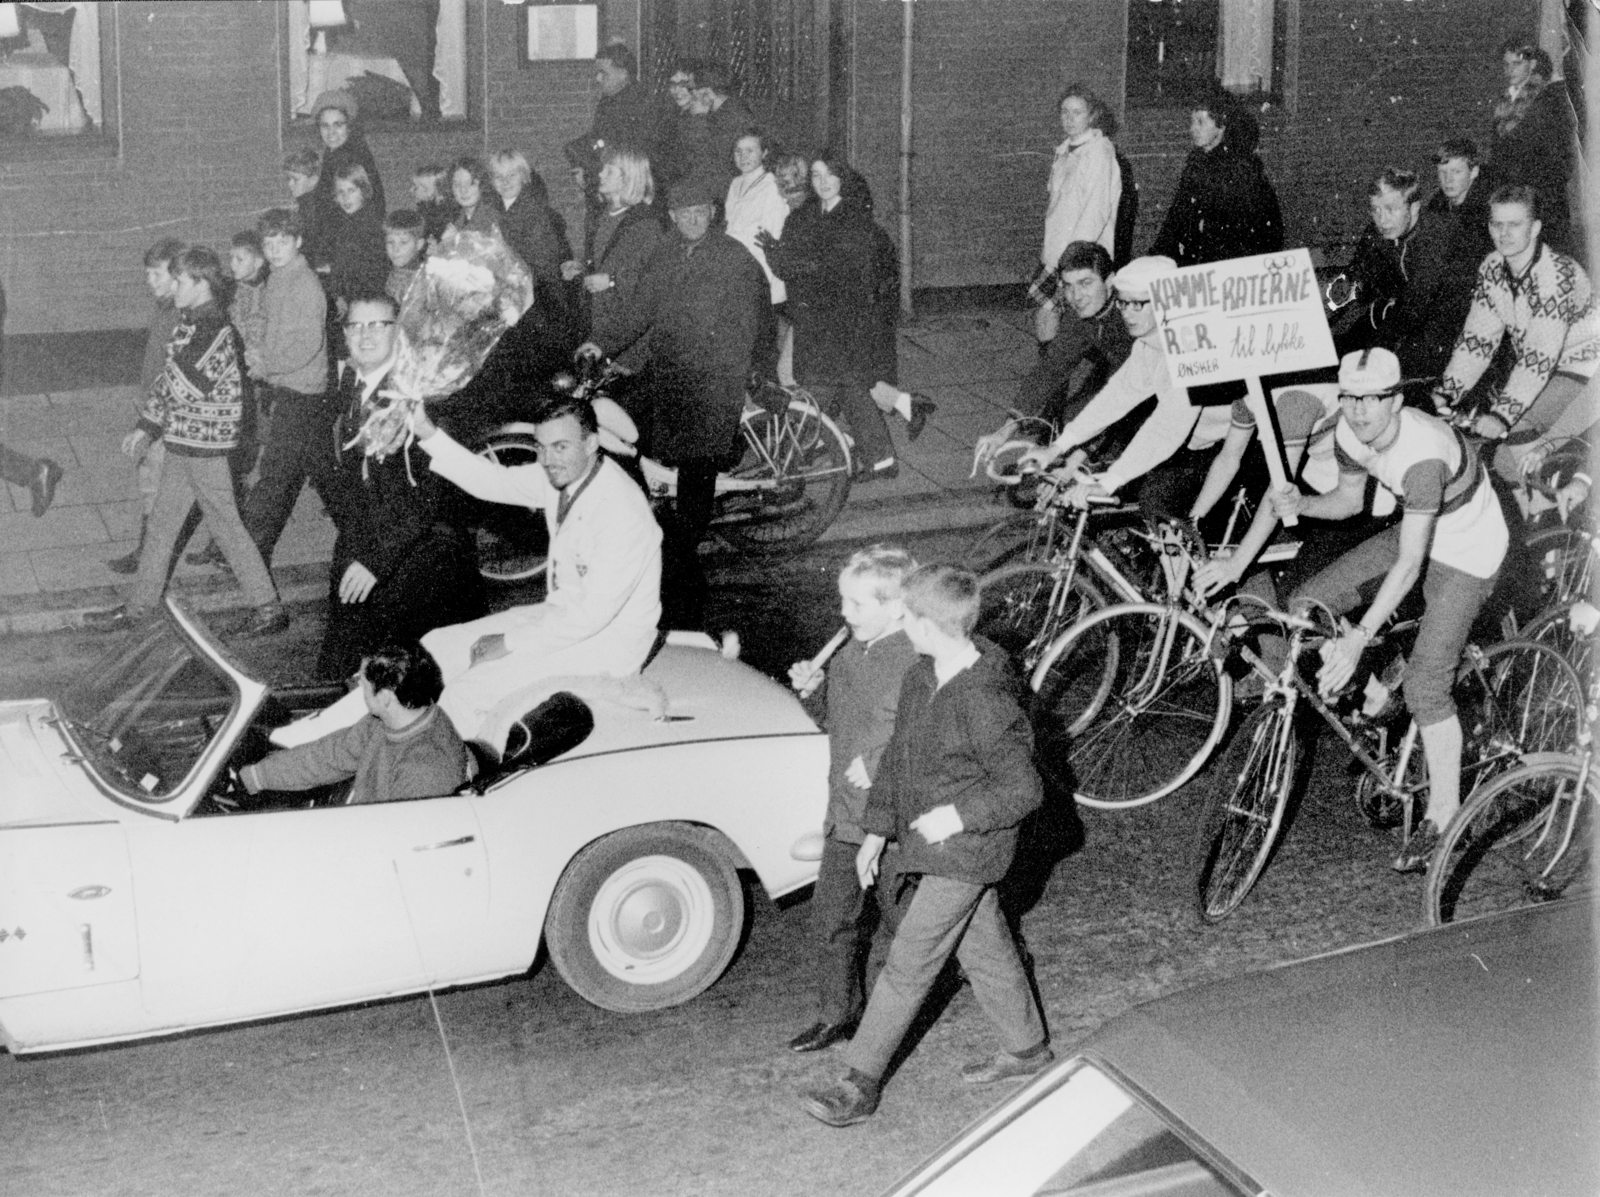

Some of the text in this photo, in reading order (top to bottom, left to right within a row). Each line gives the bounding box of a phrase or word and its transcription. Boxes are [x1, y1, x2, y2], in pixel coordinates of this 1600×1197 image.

[1230, 324, 1255, 358] til
[1261, 322, 1305, 363] lykke
[1177, 358, 1219, 378] ØNSKER
